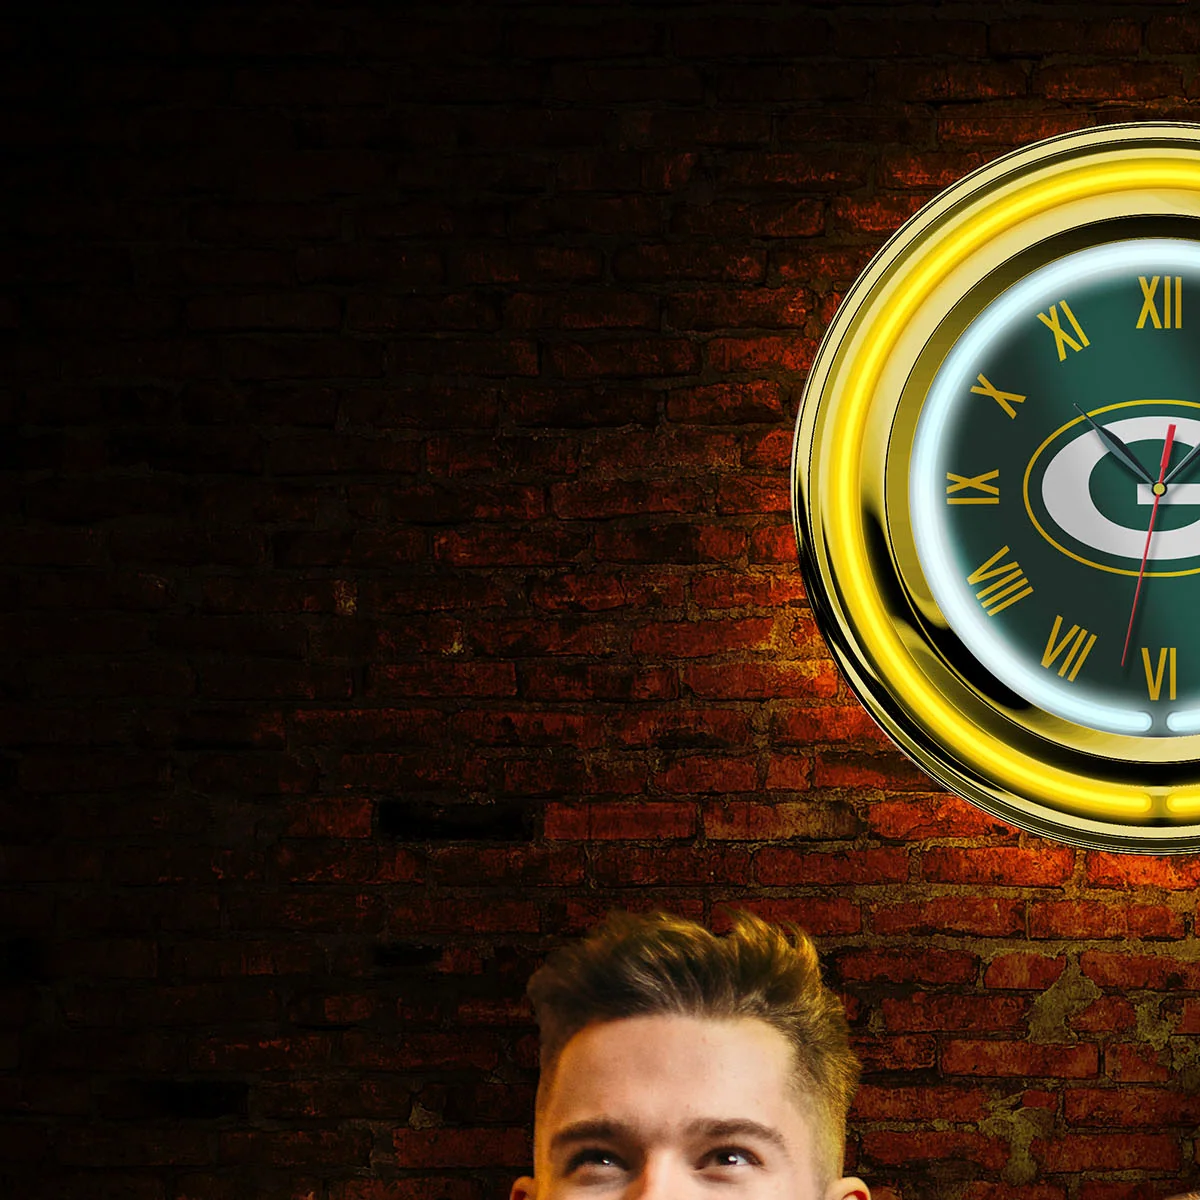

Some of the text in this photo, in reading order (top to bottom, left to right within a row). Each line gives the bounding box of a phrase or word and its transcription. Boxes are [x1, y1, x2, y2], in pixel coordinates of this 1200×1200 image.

[1136, 276, 1183, 329] XII
[1037, 300, 1091, 362] XI
[971, 373, 1027, 420] X
[946, 469, 1000, 505] IX
[966, 545, 1034, 617] VIII
[1040, 615, 1098, 682] VII
[1141, 647, 1177, 701] VI
